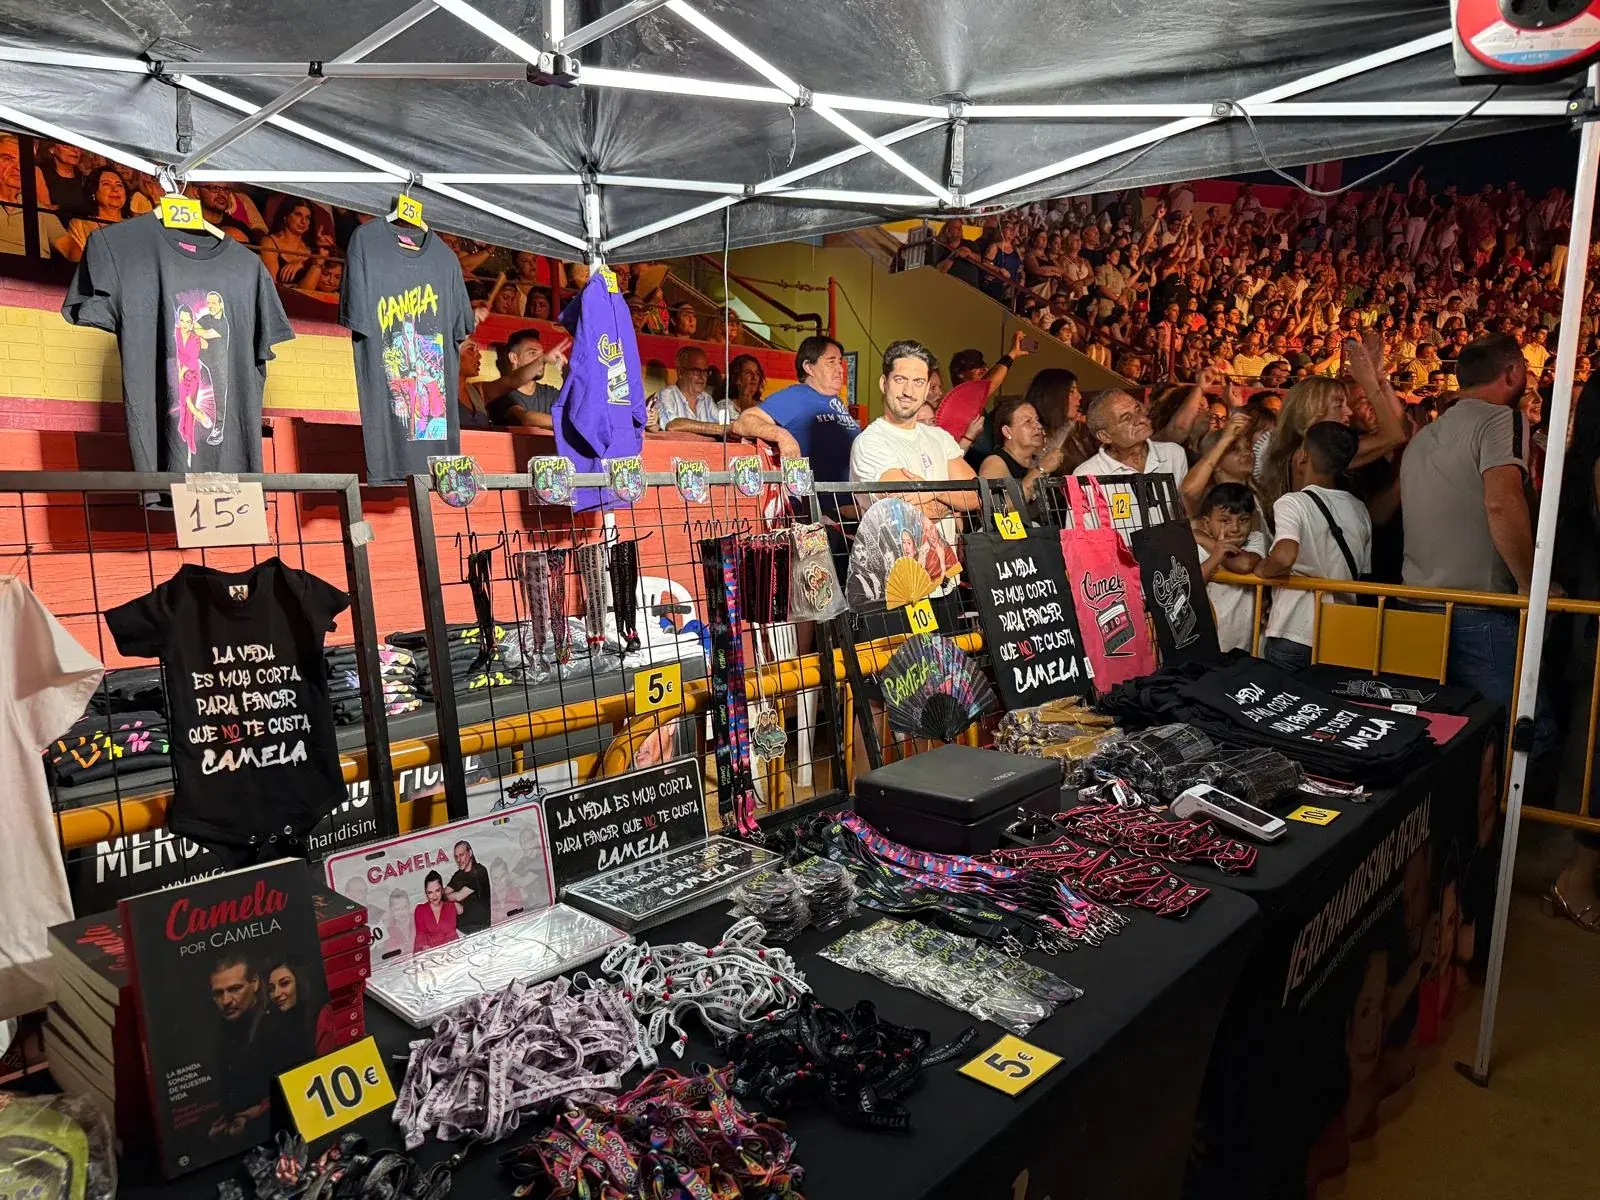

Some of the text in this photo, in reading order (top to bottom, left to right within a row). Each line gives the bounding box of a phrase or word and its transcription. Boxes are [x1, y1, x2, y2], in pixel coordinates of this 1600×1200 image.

[169, 205, 199, 223] 25€
[377, 283, 438, 333] CAMELA
[816, 414, 835, 423] NEW
[995, 556, 1037, 580] LA VIDA
[991, 587, 1005, 606] ES
[1005, 585, 1025, 604] MUY
[912, 608, 932, 629] 10€
[999, 602, 1064, 632] PARA FINGIR
[212, 643, 275, 665] LA VIDA
[1000, 642, 1019, 661] QUE
[1017, 640, 1033, 656] NO
[1030, 635, 1044, 653] TE
[192, 665, 302, 690] ES MUY CORTA
[649, 672, 672, 703] 5€
[884, 655, 930, 706] CAMELA
[1013, 655, 1079, 693] CAMELA
[196, 689, 297, 716] PARA FINGIR
[189, 713, 311, 744] QUE NO TE GUSTA
[1334, 718, 1397, 750] AMELA
[201, 740, 307, 775] CAMELA
[556, 775, 693, 830] LA VIDA ES MUY CORTA
[555, 799, 699, 855] PARA FINGIR QUE NO TE GUSTA
[598, 830, 669, 871] CAMELA
[367, 848, 449, 884] CAMELA
[663, 863, 740, 895] CAMELA
[166, 880, 288, 941] Camela
[180, 918, 281, 957] POR CAMELA
[166, 1062, 201, 1079] LA BANDA
[168, 1072, 199, 1087] SONORA
[984, 1051, 1033, 1078] 5€
[169, 1092, 188, 1102] VIDA
[180, 1075, 212, 1090] NUESTRA
[306, 1065, 379, 1118] 10€
